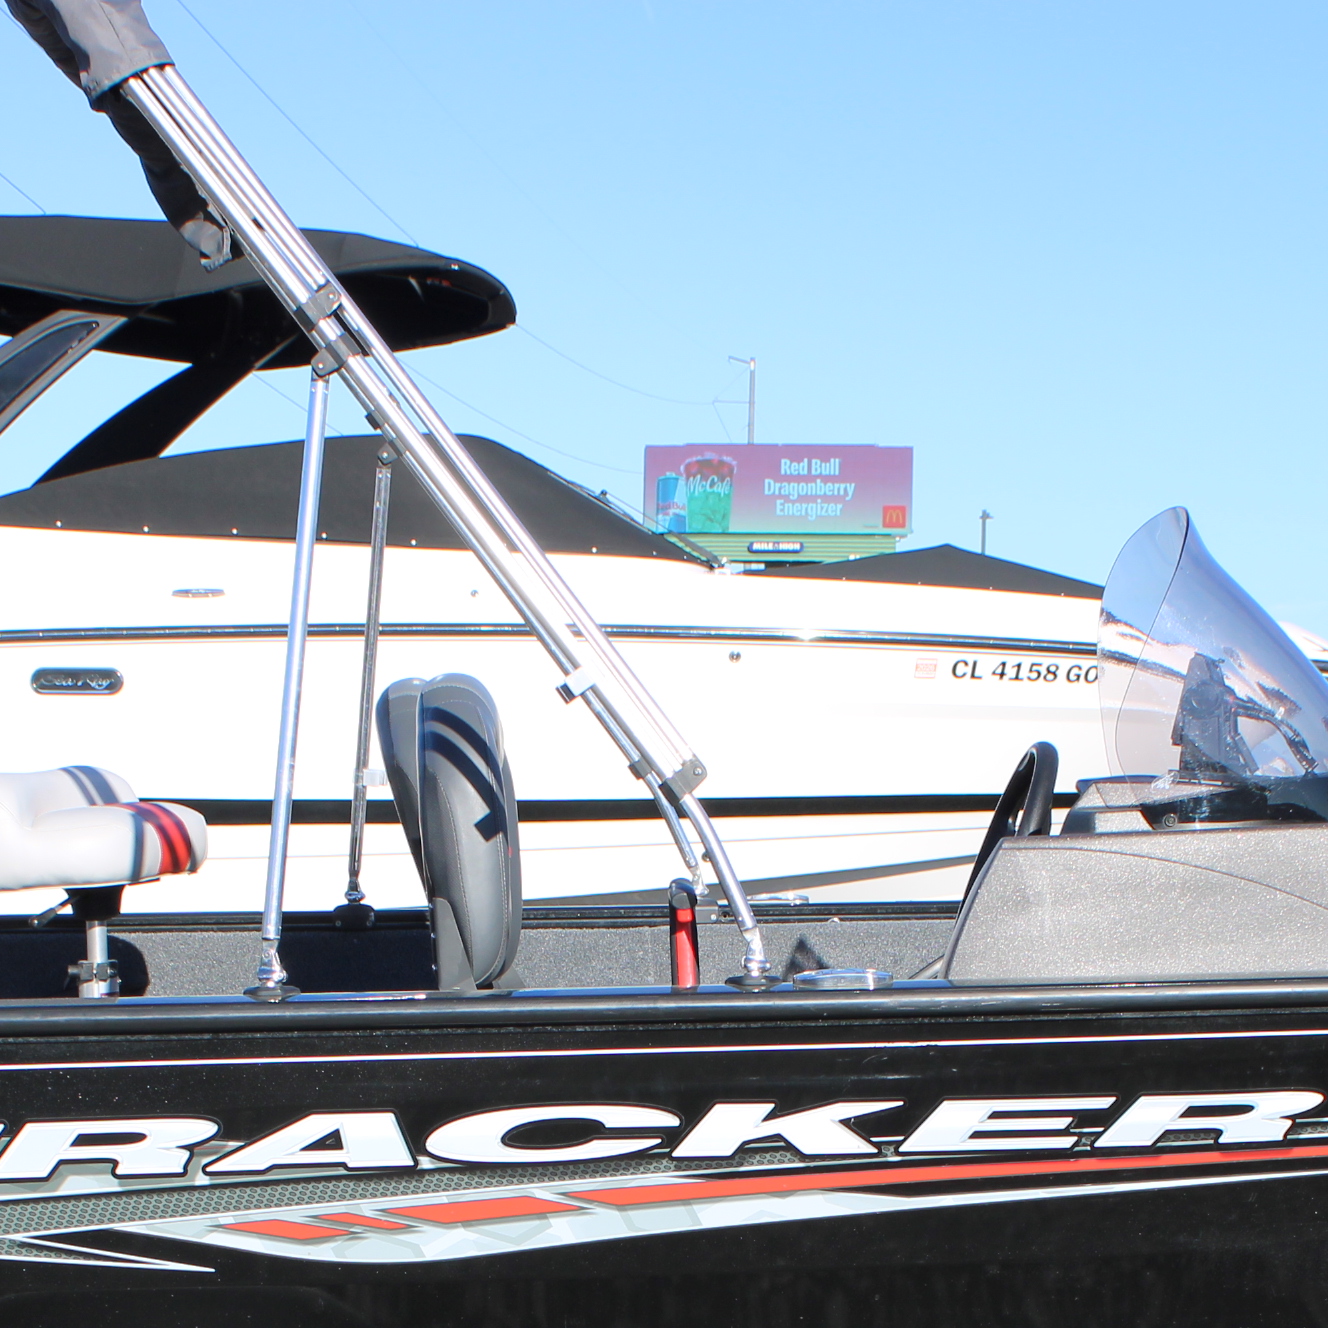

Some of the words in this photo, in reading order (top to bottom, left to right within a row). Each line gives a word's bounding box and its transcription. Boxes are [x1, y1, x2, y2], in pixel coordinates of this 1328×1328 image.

[781, 458, 808, 475] Red
[811, 458, 840, 475] Bull
[764, 479, 855, 500] Dragonberry
[776, 499, 843, 521] Energizer
[753, 542, 774, 550] MILE
[951, 659, 983, 680] CL
[992, 661, 1059, 683] 4158
